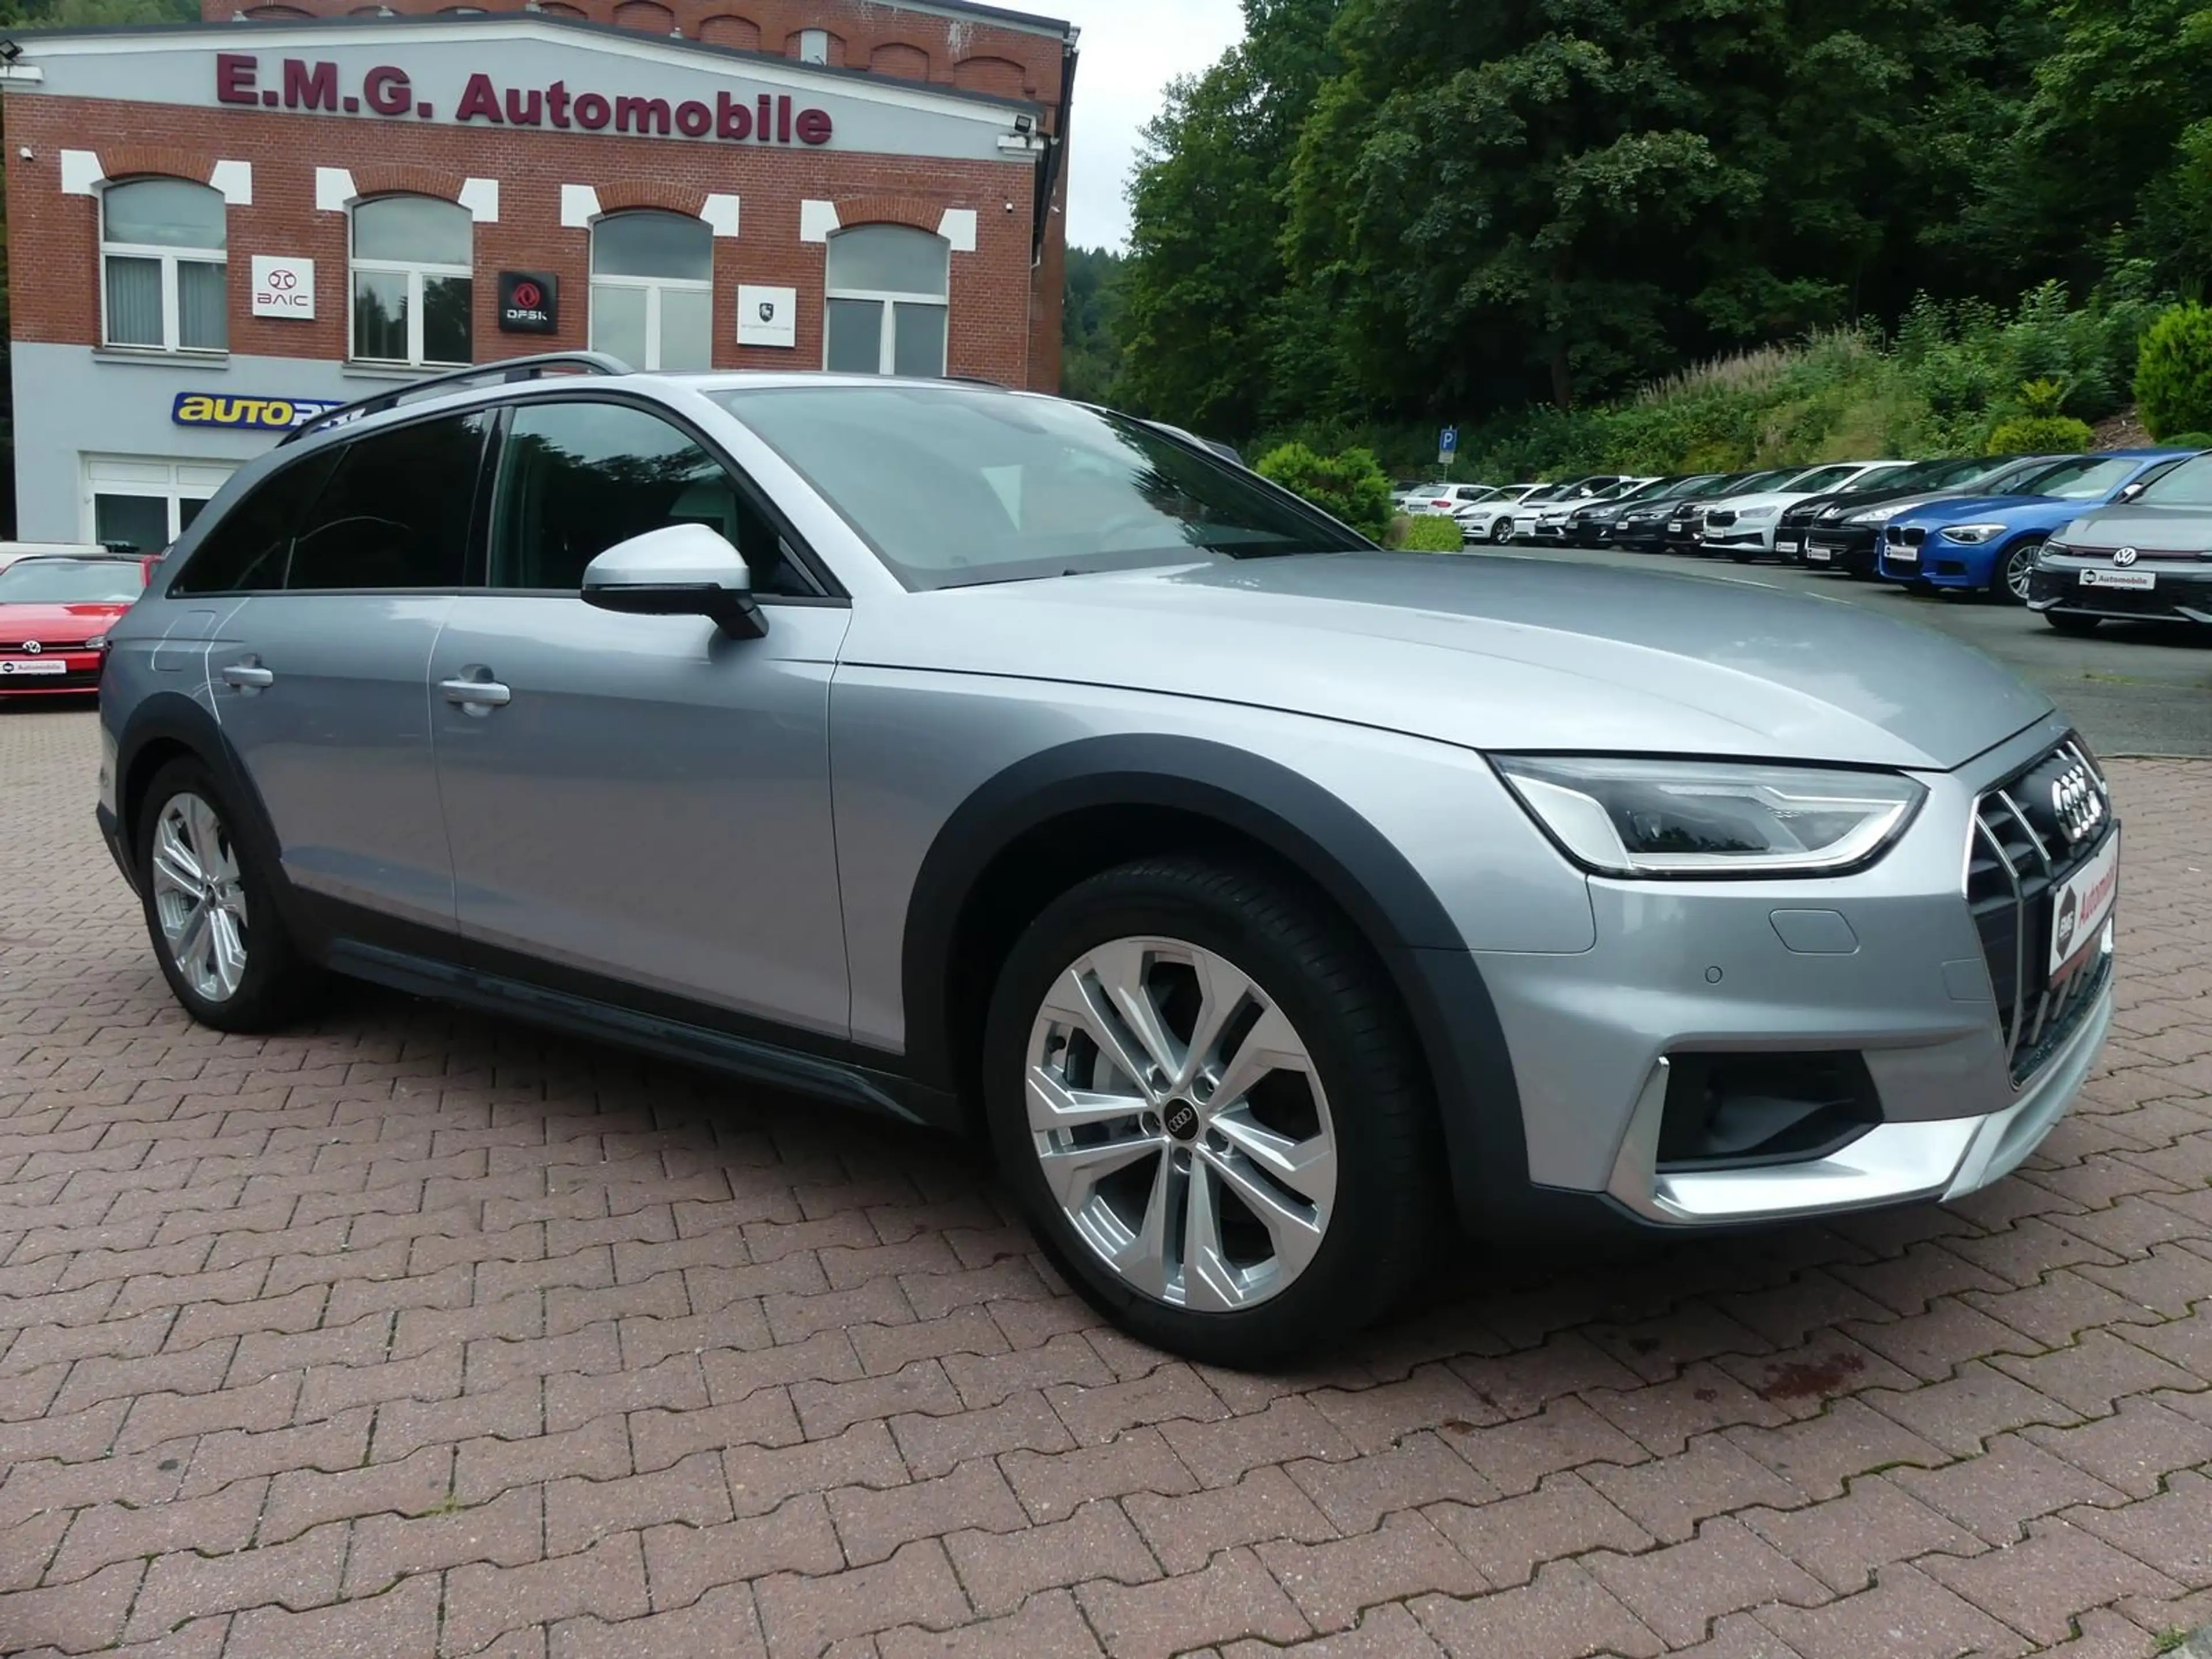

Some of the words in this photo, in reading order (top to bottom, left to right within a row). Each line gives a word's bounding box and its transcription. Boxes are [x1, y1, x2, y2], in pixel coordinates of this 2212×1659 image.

[217, 53, 433, 119] E.M.G.
[455, 73, 833, 145] Automobile
[257, 293, 309, 306] BAIC
[507, 309, 548, 321] DFSK
[1443, 433, 1453, 449] P
[2099, 575, 2148, 585] Automobile
[2078, 855, 2115, 929] Automob
